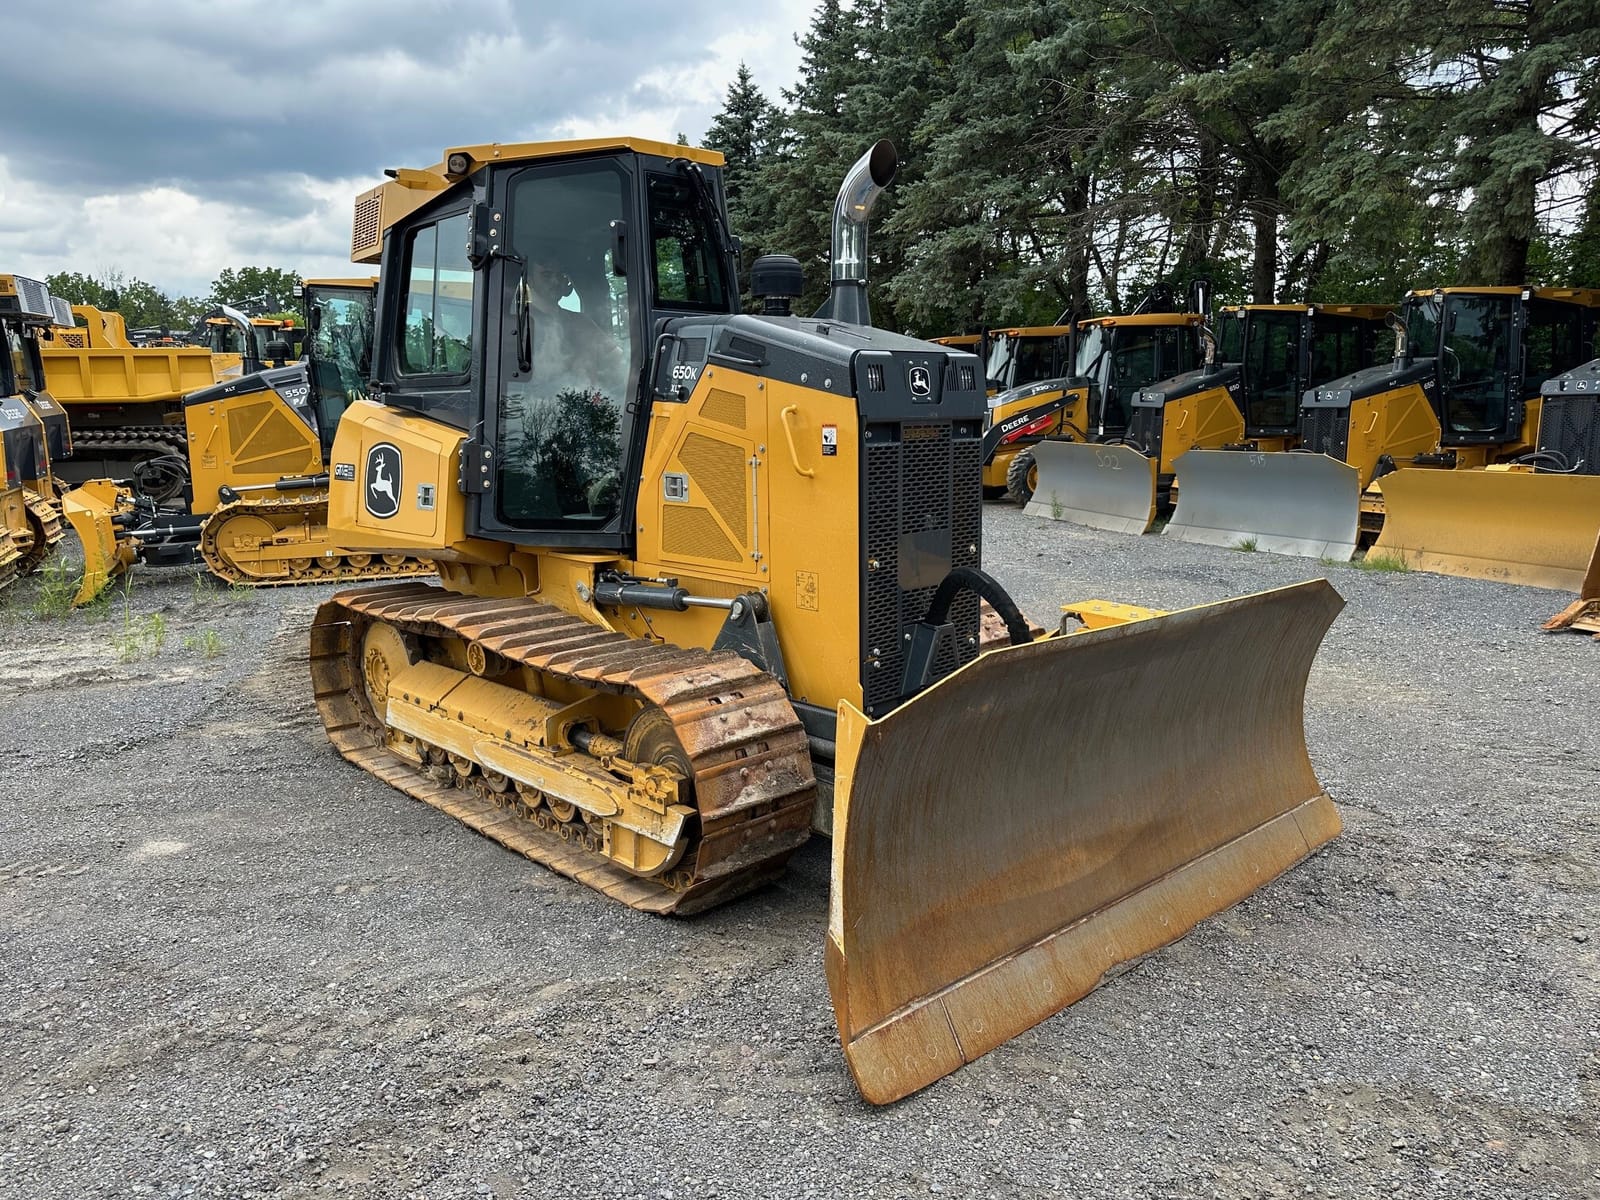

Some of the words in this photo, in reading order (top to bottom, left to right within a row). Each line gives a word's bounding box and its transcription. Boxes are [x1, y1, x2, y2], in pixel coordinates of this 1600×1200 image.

[672, 365, 698, 380] 650K
[224, 385, 236, 393] XLT
[285, 387, 308, 398] 550
[1001, 414, 1030, 433] DEERE
